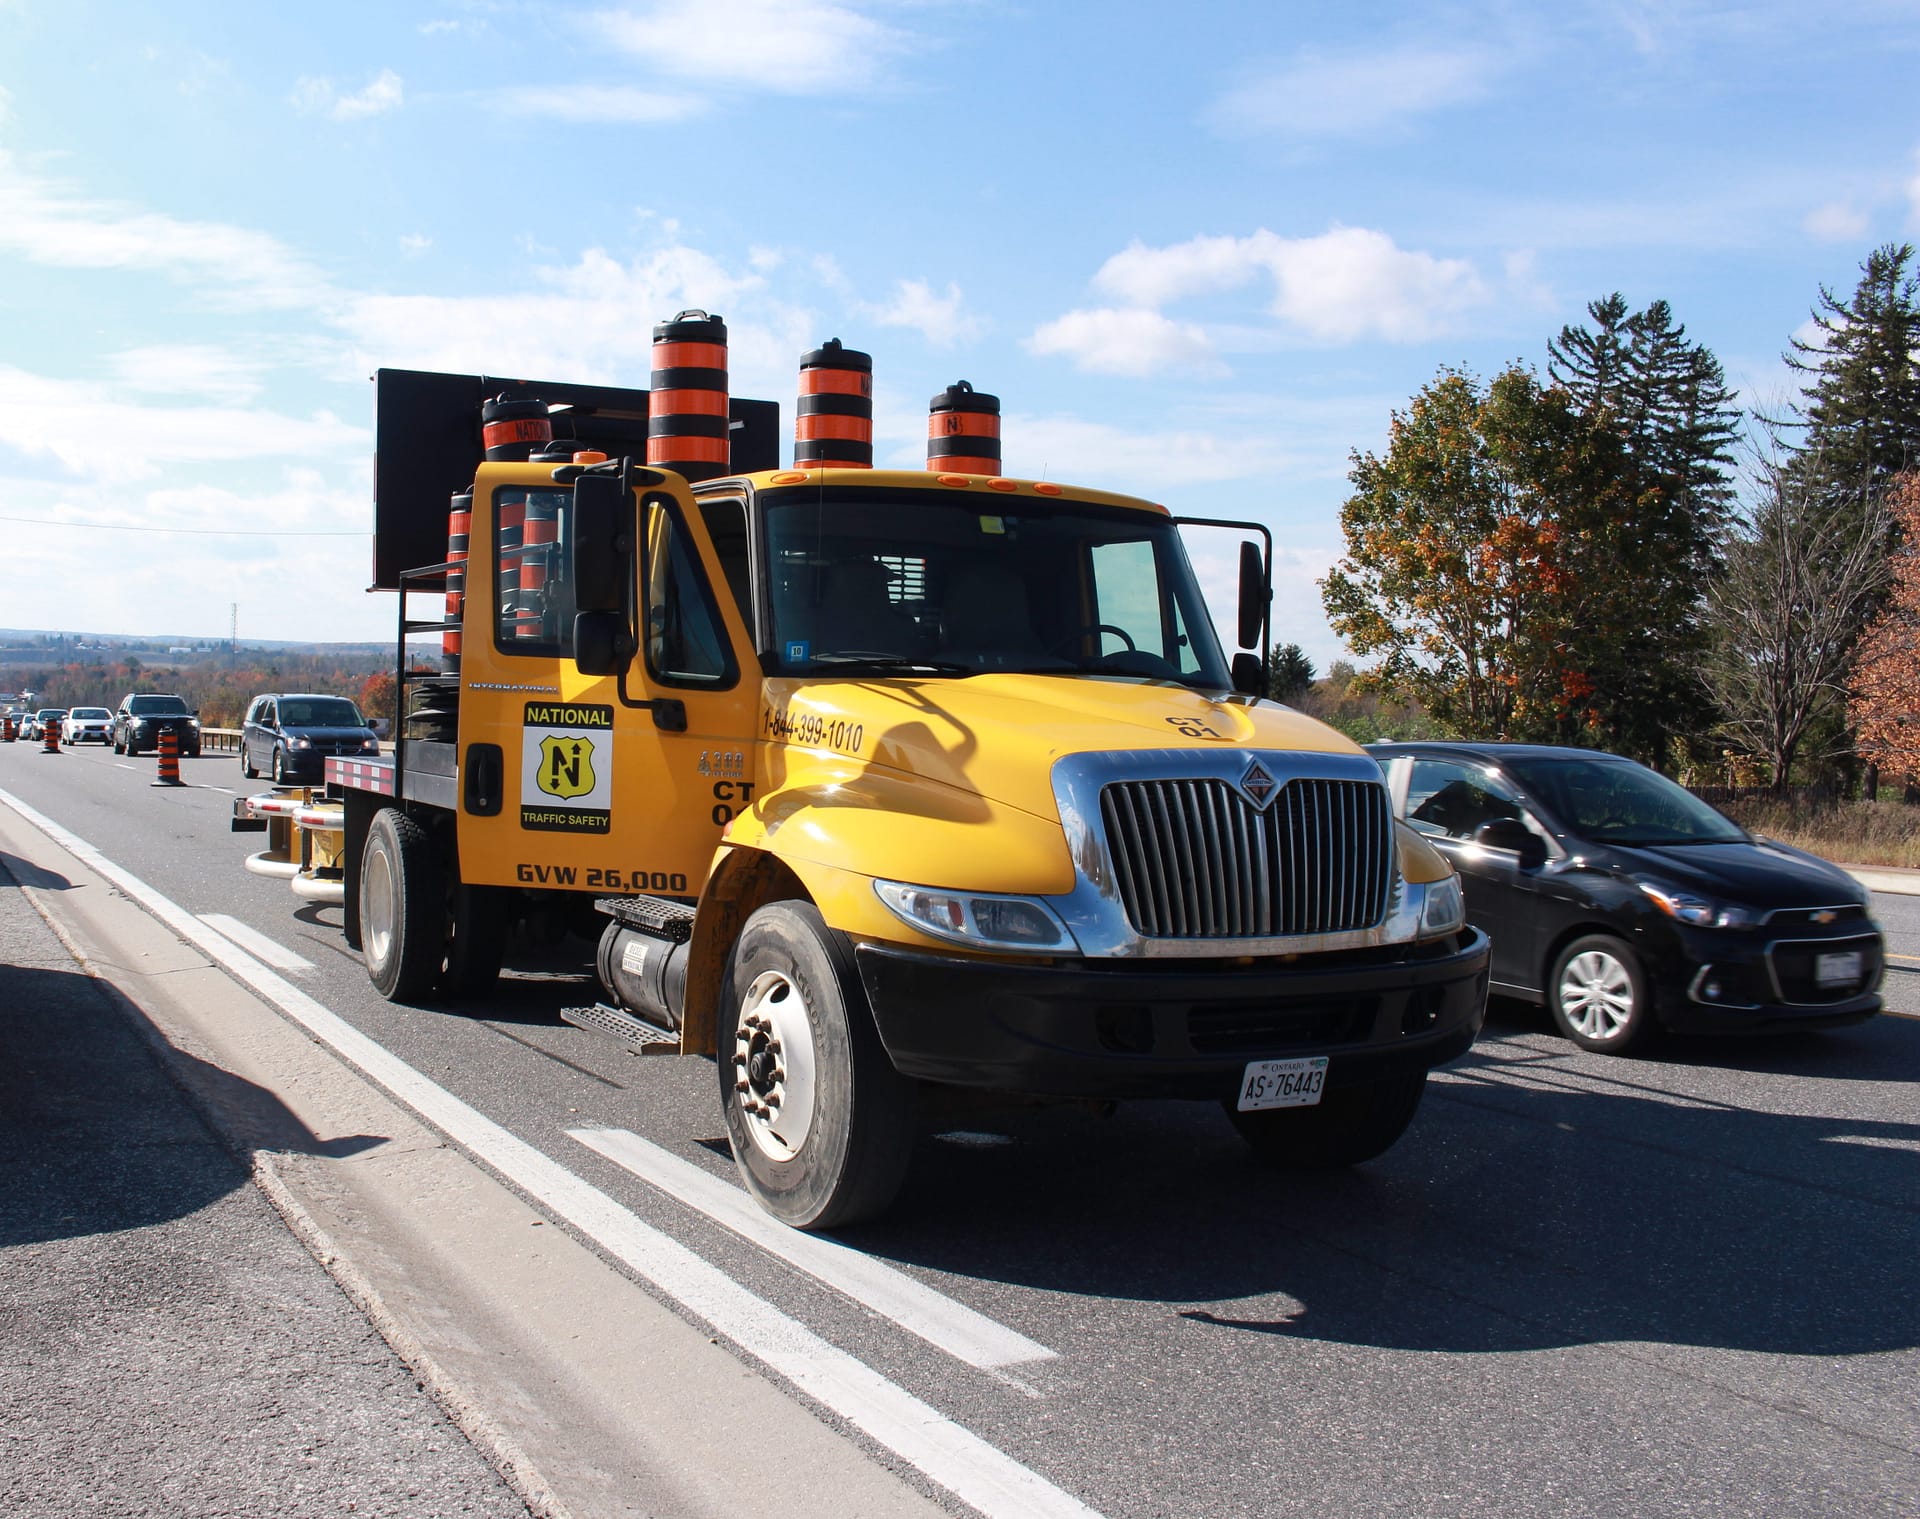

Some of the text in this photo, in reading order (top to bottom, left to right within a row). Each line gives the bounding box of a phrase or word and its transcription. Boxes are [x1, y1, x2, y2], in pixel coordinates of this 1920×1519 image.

[527, 707, 611, 726] NATIONAL
[1165, 716, 1205, 727] CT
[763, 707, 864, 753] 1-844-399-1010
[1178, 726, 1222, 738] 01
[712, 780, 755, 802] CT
[522, 812, 609, 827] TRAFFIC SAFETY
[712, 803, 749, 827] 0
[516, 863, 687, 892] GVW 26,000
[1271, 1062, 1305, 1073] ONTARIO
